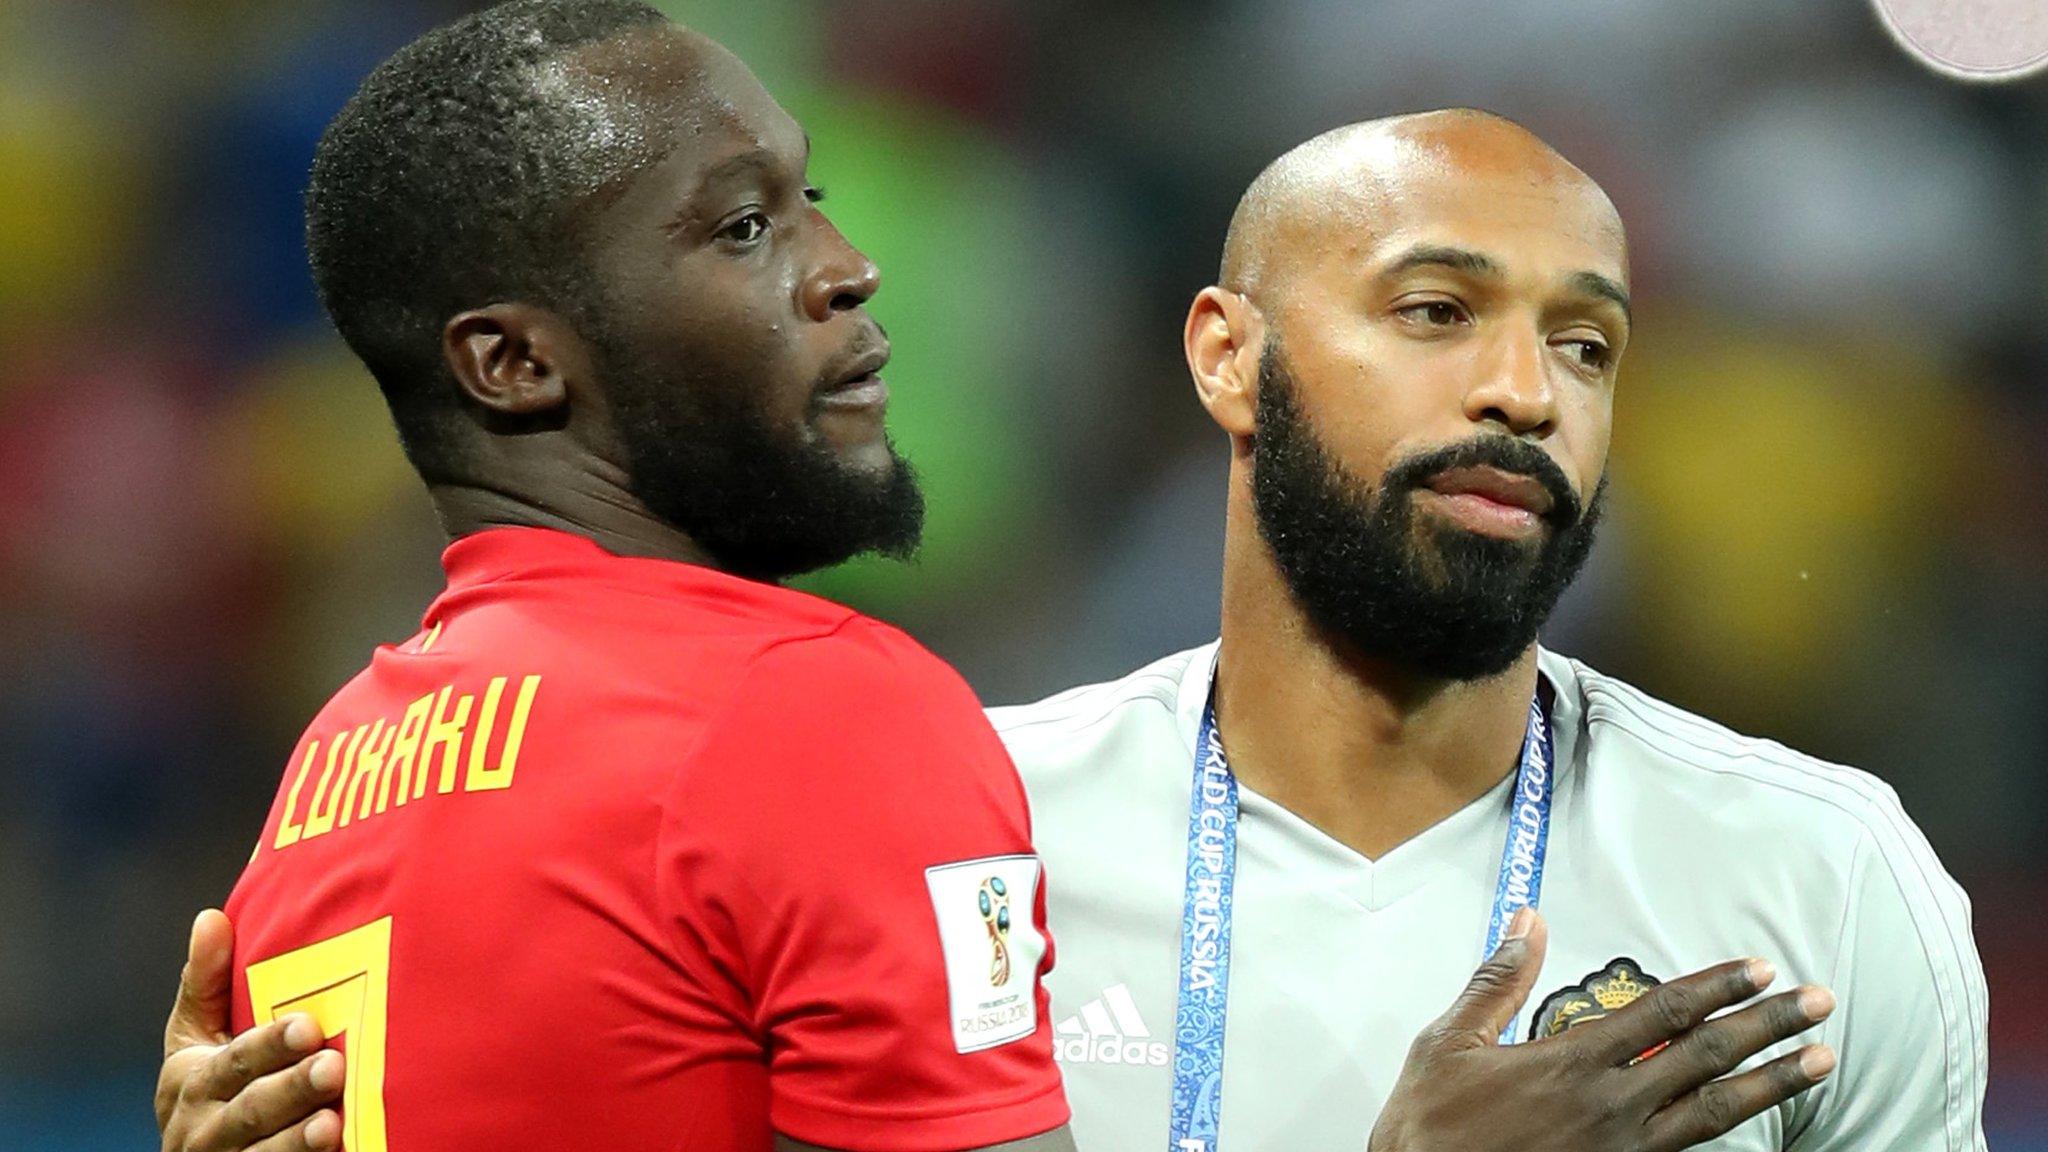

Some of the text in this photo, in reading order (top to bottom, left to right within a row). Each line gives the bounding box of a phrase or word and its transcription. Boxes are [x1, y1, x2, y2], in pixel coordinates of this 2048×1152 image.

[274, 674, 541, 850] LUKAKU
[1190, 710, 1228, 991] ORLD CUP RUSSIA
[1505, 803, 1541, 905] WORLD
[1524, 740, 1547, 802] CUP
[246, 915, 393, 1152] 7
